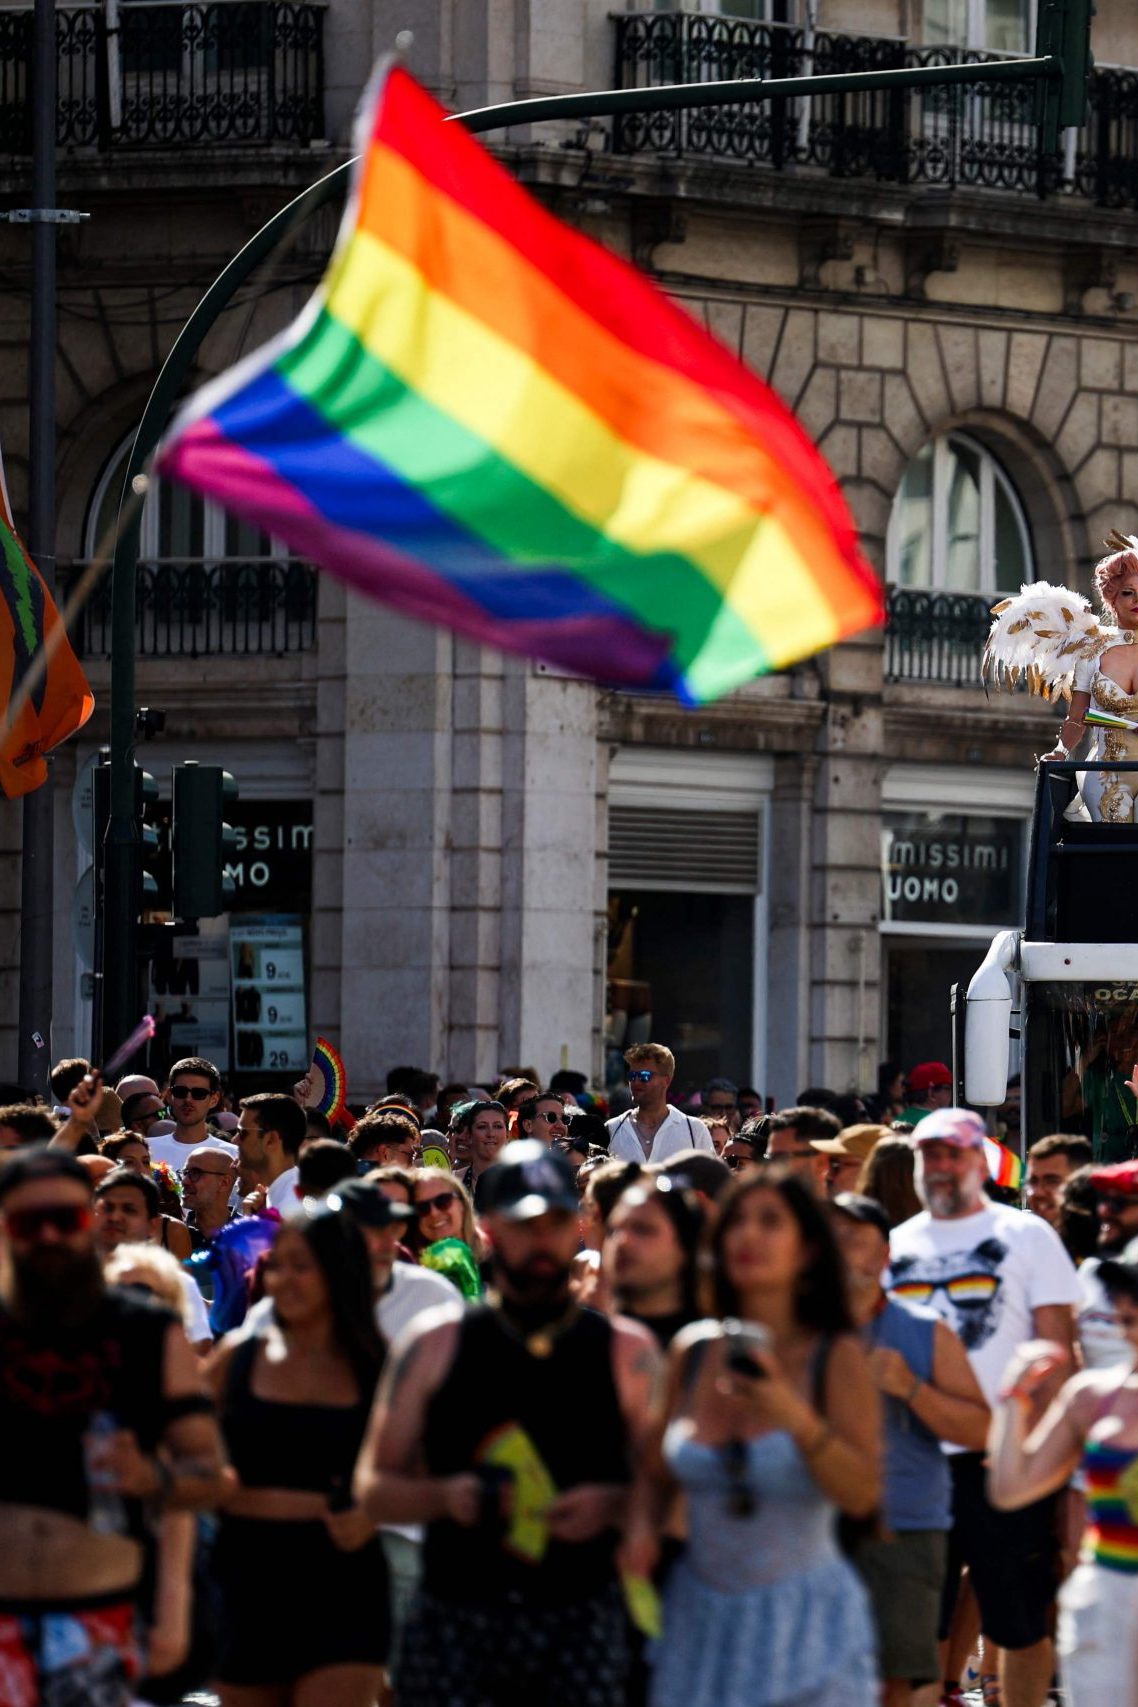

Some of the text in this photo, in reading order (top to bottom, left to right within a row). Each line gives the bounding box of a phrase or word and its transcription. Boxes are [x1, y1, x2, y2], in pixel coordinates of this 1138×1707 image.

[887, 875, 959, 904] UOMO
[266, 962, 276, 979] 9
[267, 1006, 278, 1024] 9
